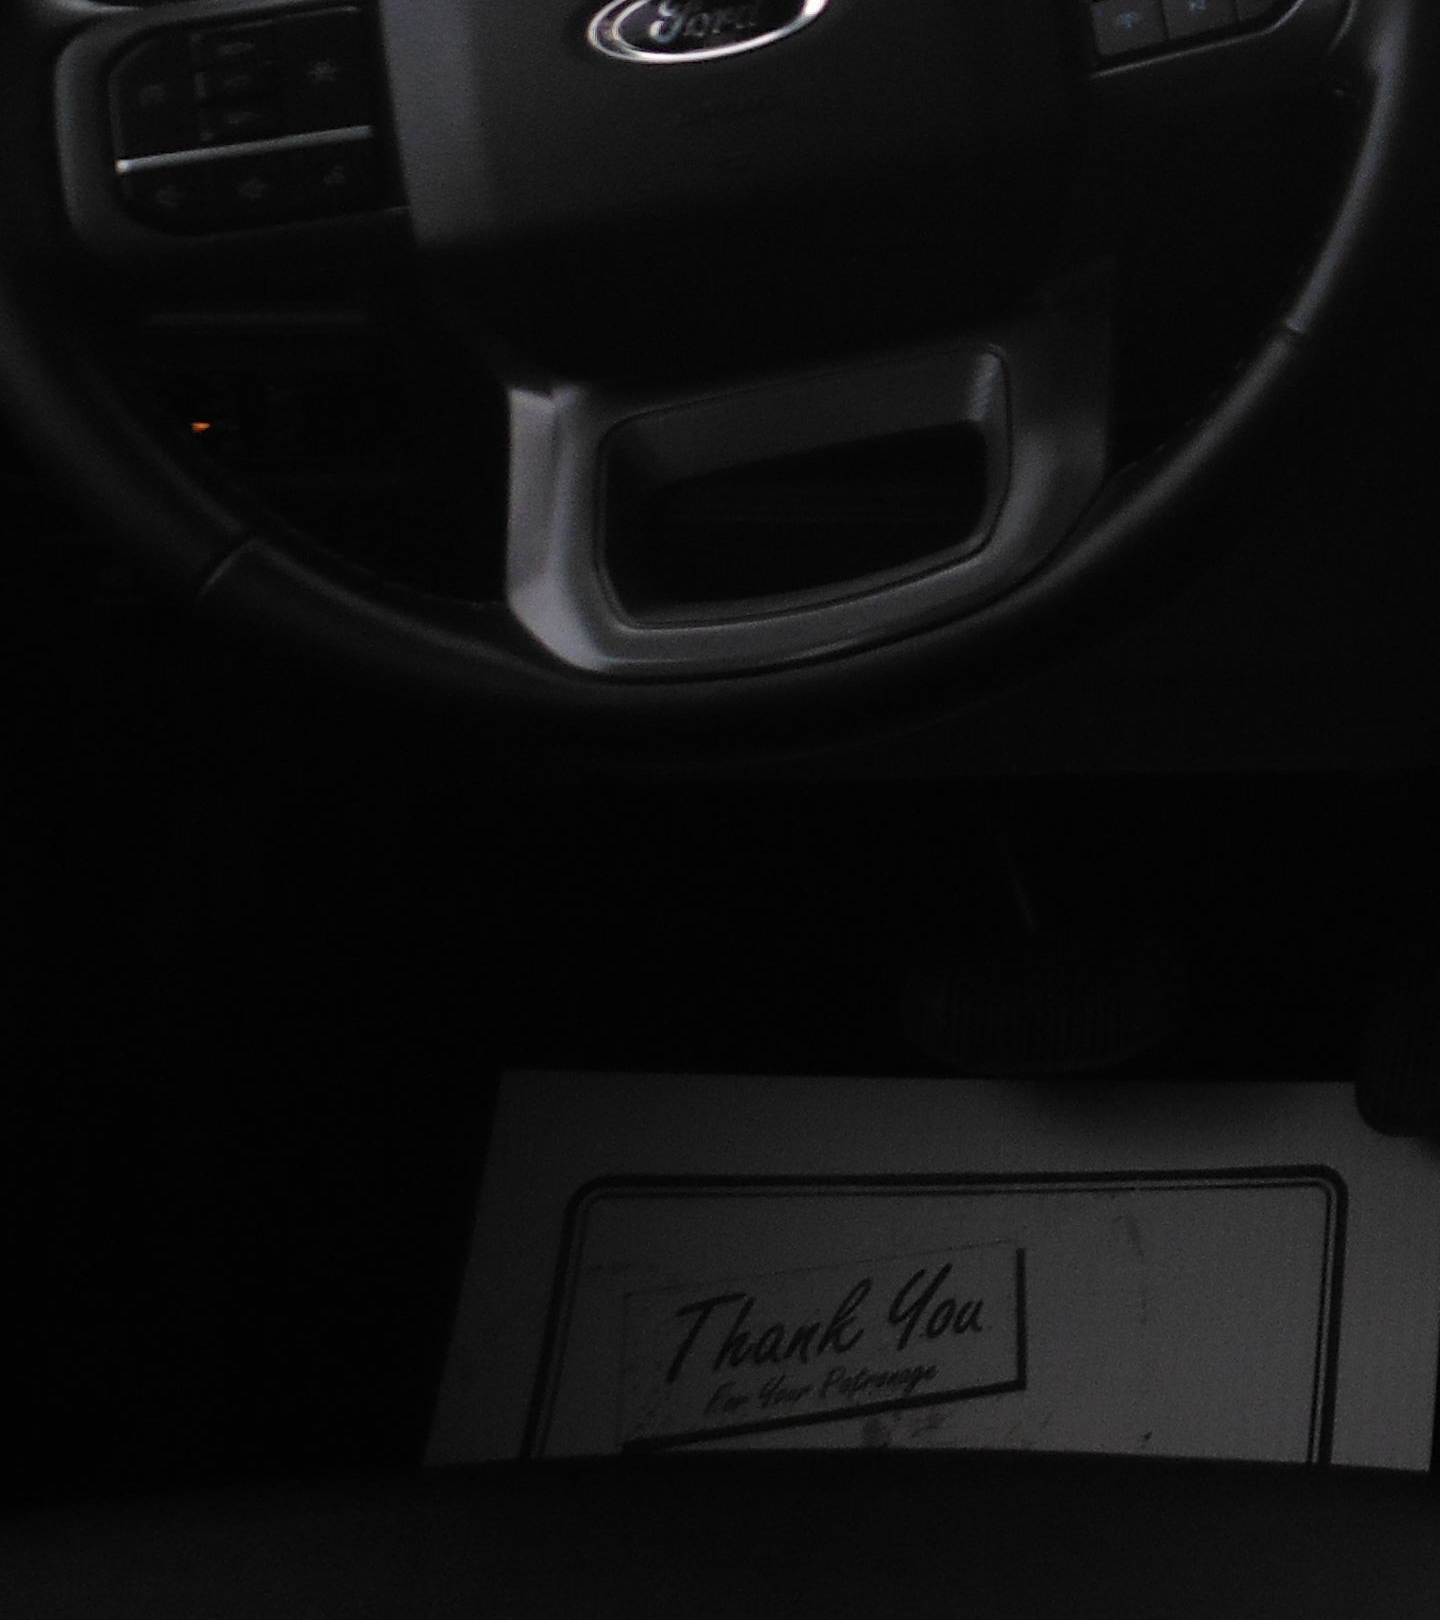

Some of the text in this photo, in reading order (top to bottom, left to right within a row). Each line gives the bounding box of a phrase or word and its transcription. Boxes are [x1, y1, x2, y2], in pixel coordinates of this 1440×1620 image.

[664, 1262, 984, 1385] Thank You
[702, 1364, 938, 1416] For Your Patronage
